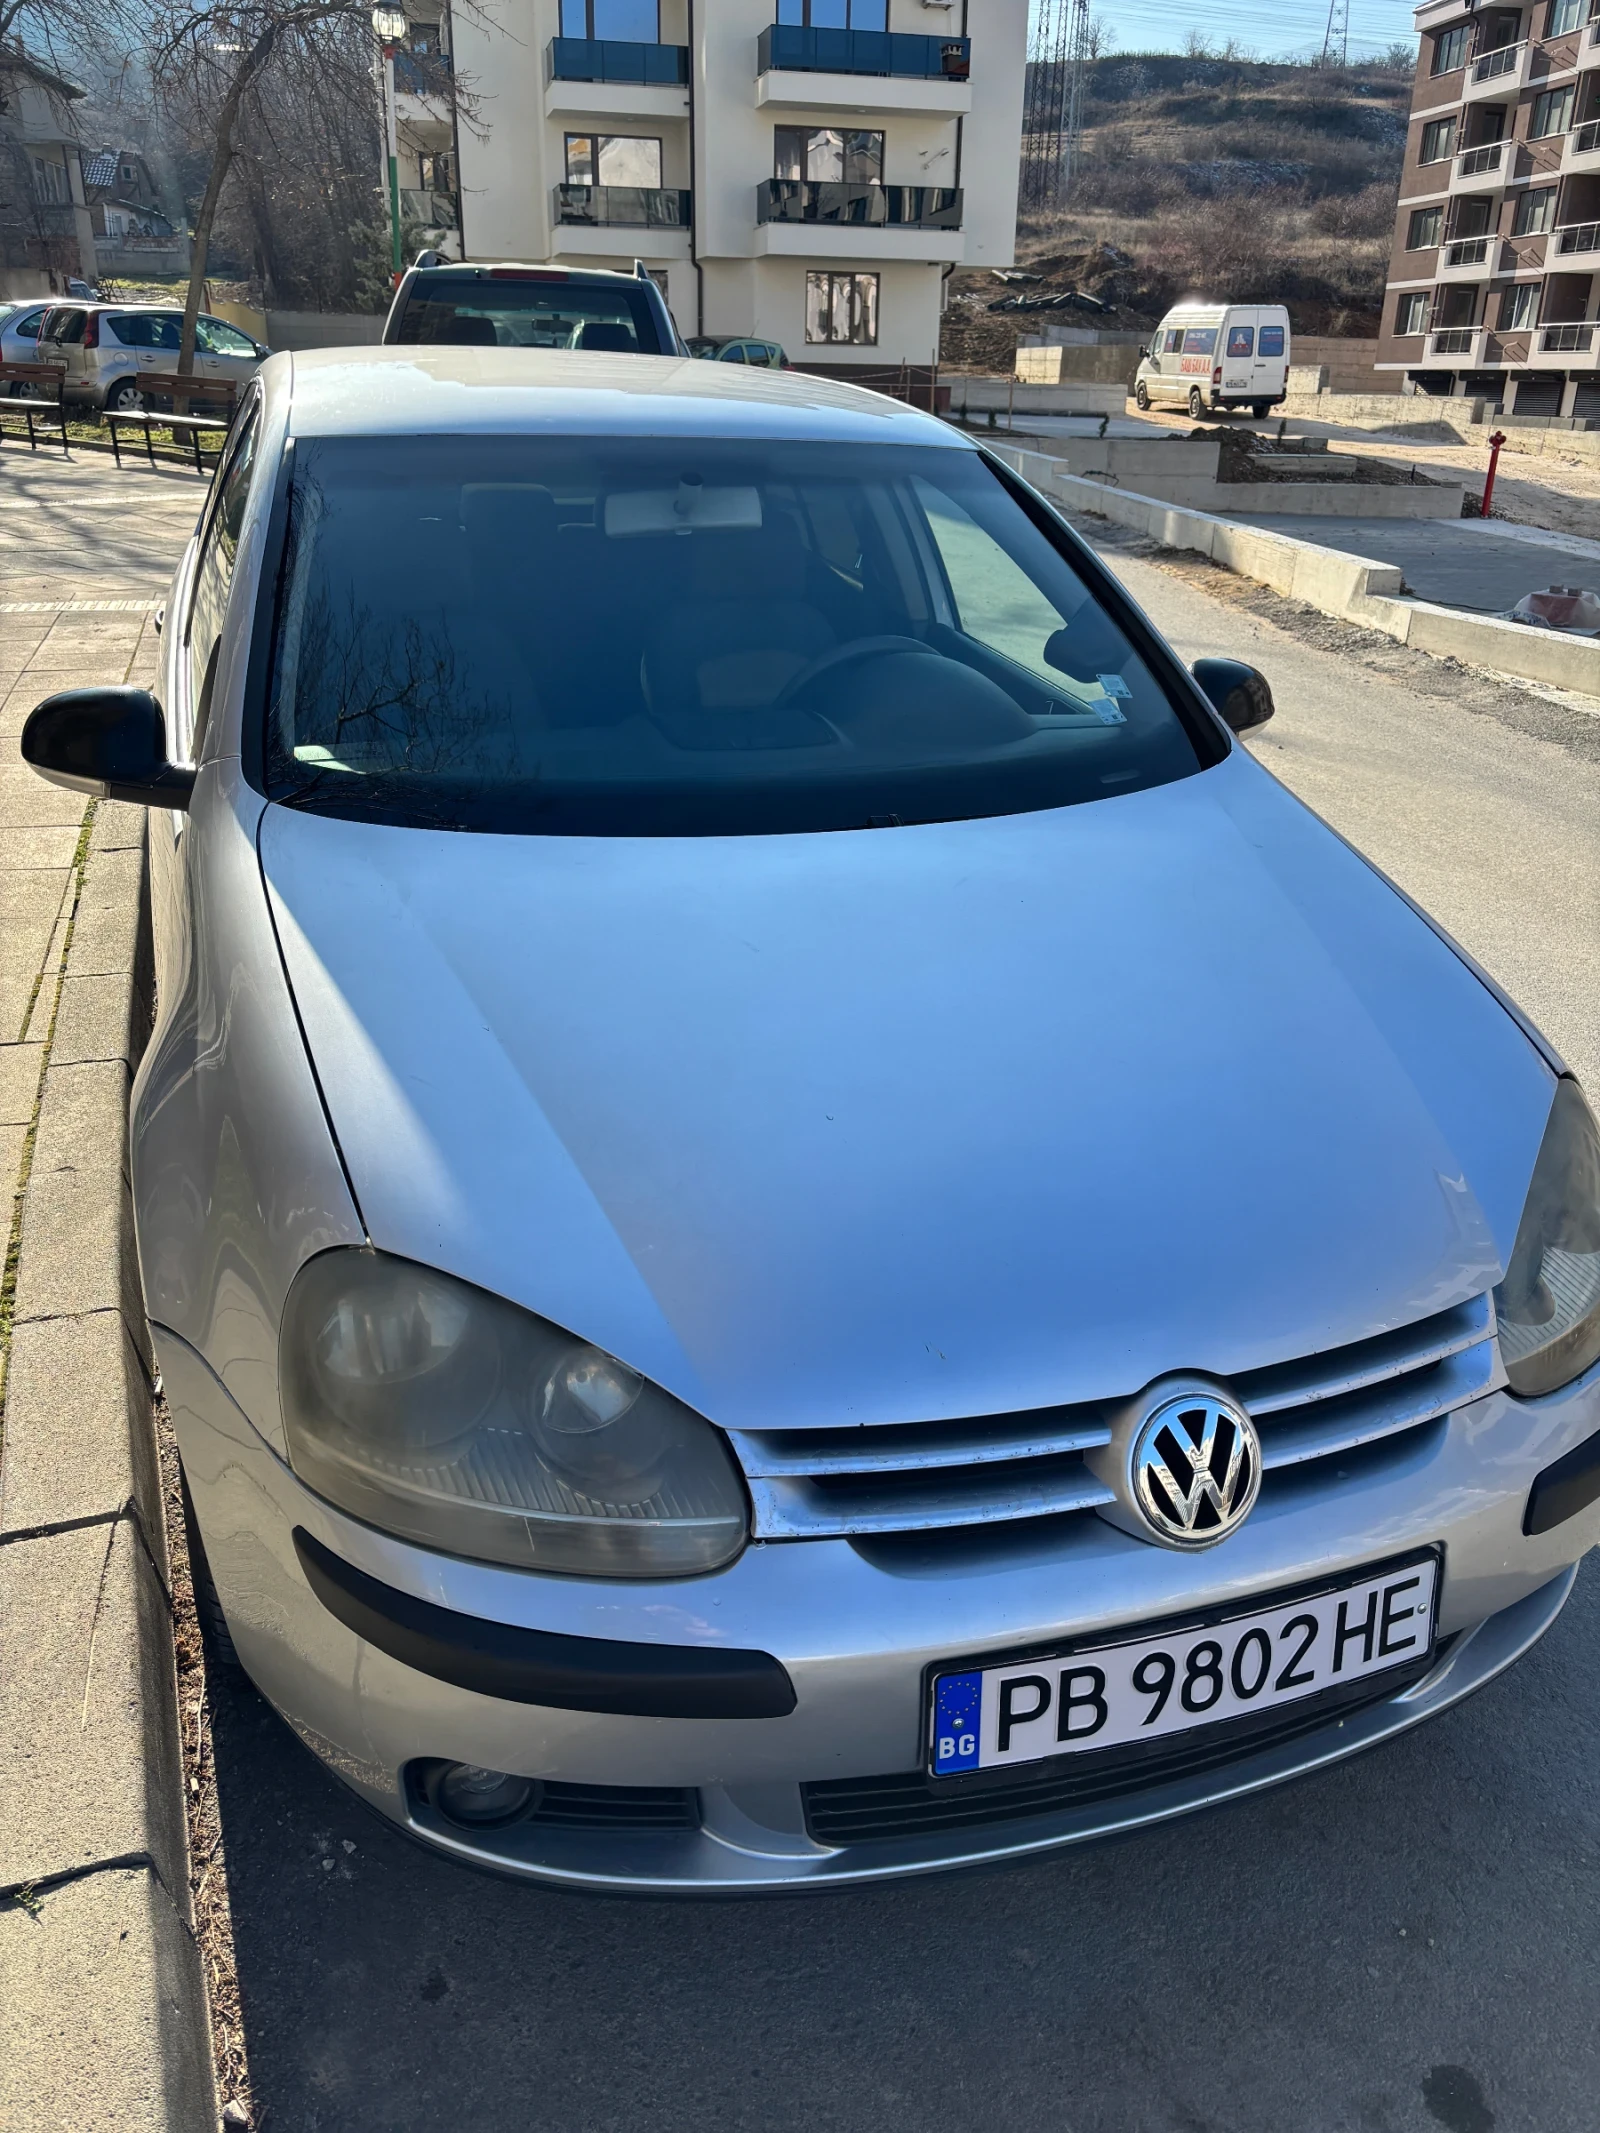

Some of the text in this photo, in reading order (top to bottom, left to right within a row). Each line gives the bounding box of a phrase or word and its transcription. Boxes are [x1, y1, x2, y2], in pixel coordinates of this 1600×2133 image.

[1137, 1395, 1257, 1540] VW
[998, 1577, 1420, 1752] PB 9802 HE
[939, 1734, 975, 1760] BG
